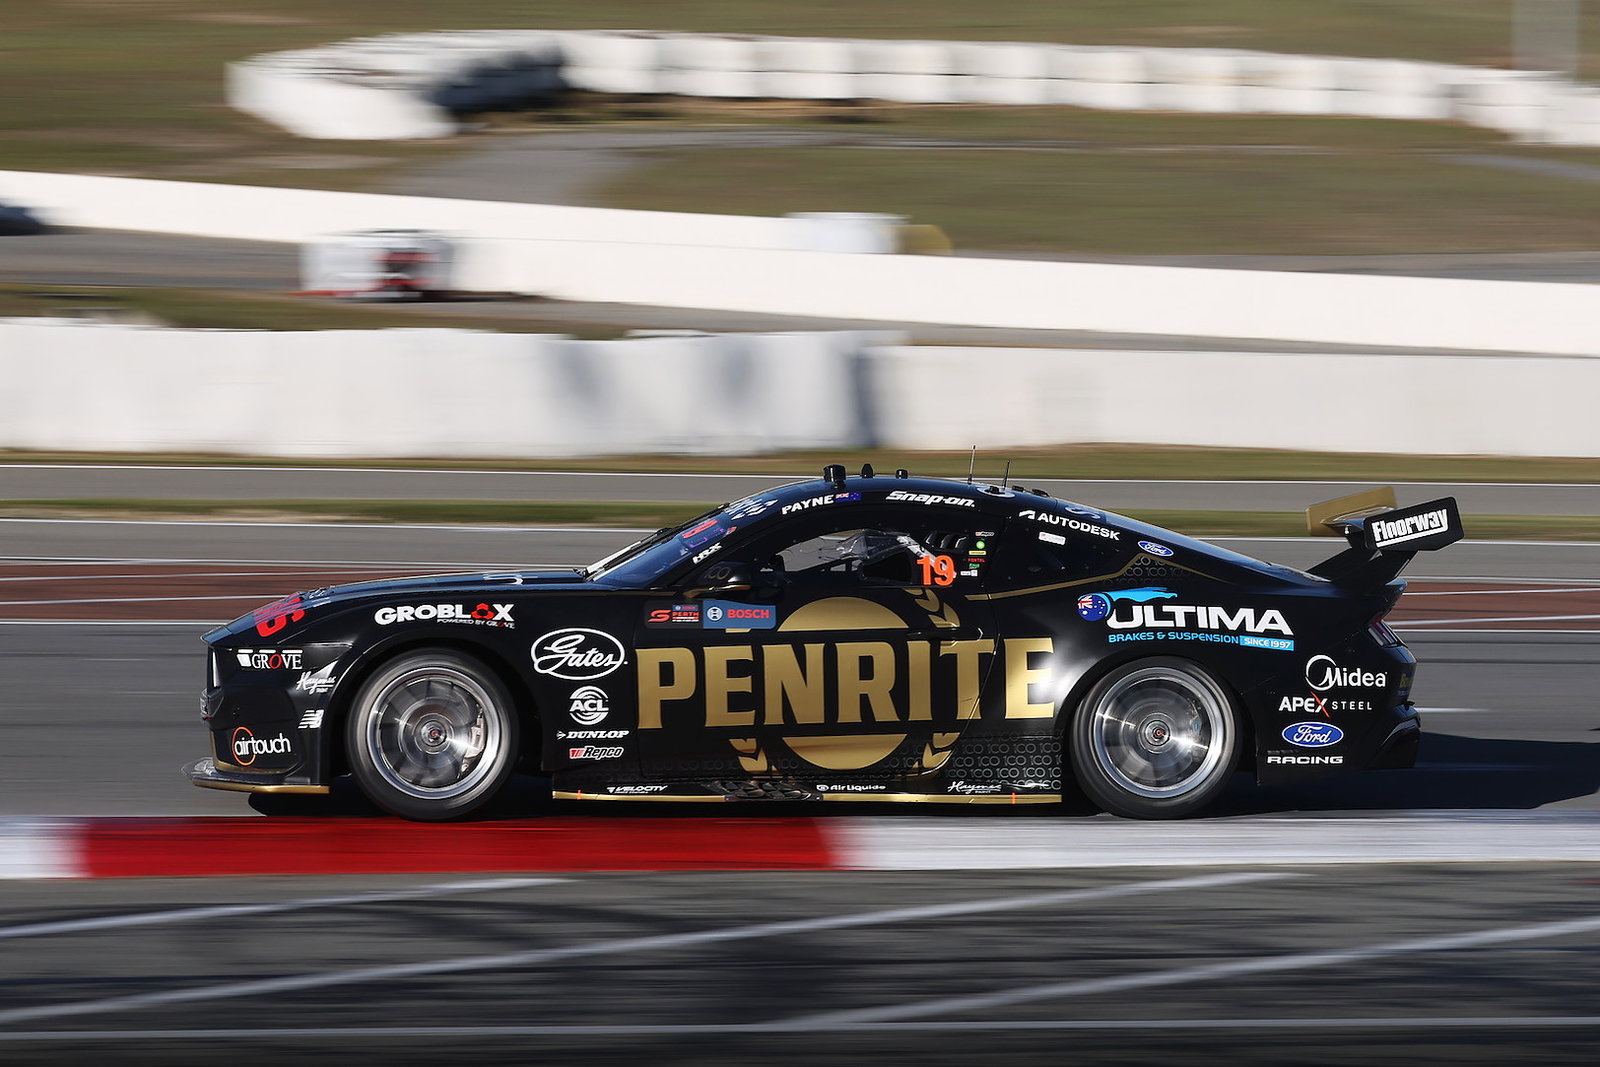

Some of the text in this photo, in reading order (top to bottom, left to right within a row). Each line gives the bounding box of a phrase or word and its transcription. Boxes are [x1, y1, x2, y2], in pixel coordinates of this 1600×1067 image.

[781, 495, 835, 515] PAYNE
[886, 490, 971, 507] Snap-on
[1037, 512, 1120, 541] AUTODESK
[1371, 509, 1449, 548] Floorway
[917, 555, 956, 587] 19
[727, 609, 770, 619] BOSCH
[1106, 605, 1293, 636] ULTIMA
[1108, 631, 1291, 649] BRAKES & SUSPENSION SINCE 1997
[251, 654, 303, 670] GROVE
[536, 634, 622, 674] Gates
[635, 637, 1055, 730] PENRITE
[1321, 667, 1387, 689] Midea
[569, 698, 609, 713] ACL
[1278, 692, 1373, 717] APEX STEEL
[234, 733, 291, 756] airtouch
[566, 730, 630, 740] DUNLOP
[583, 747, 624, 759] Repco
[1267, 756, 1343, 764] RACING
